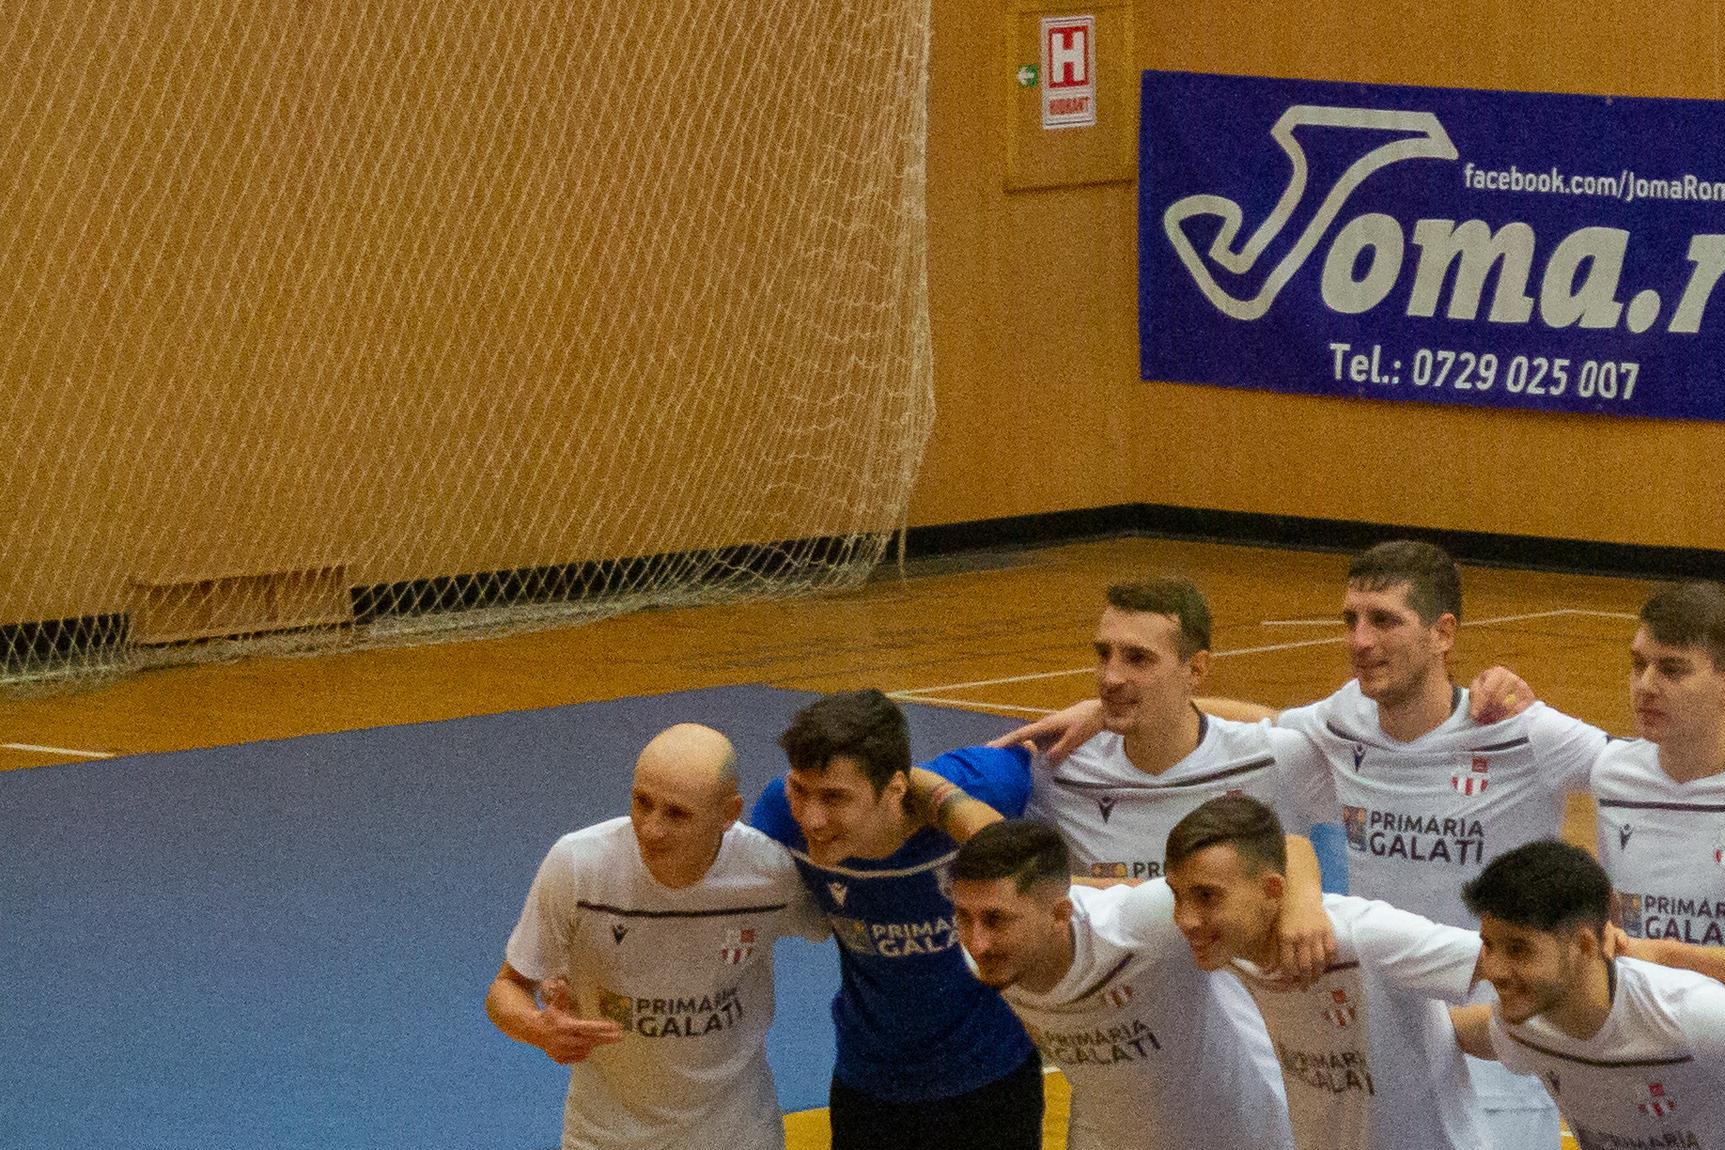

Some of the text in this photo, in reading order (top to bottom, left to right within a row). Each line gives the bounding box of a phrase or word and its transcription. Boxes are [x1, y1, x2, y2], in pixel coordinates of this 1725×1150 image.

[1051, 31, 1086, 84] H
[1330, 343, 1640, 400] Tel.: 0729 025 007
[1370, 809, 1485, 838] PRIMARIA
[1369, 832, 1485, 865] GALATI
[871, 914, 958, 939] PRIMA
[876, 930, 959, 959] GALA
[638, 1000, 744, 1038] GALATI
